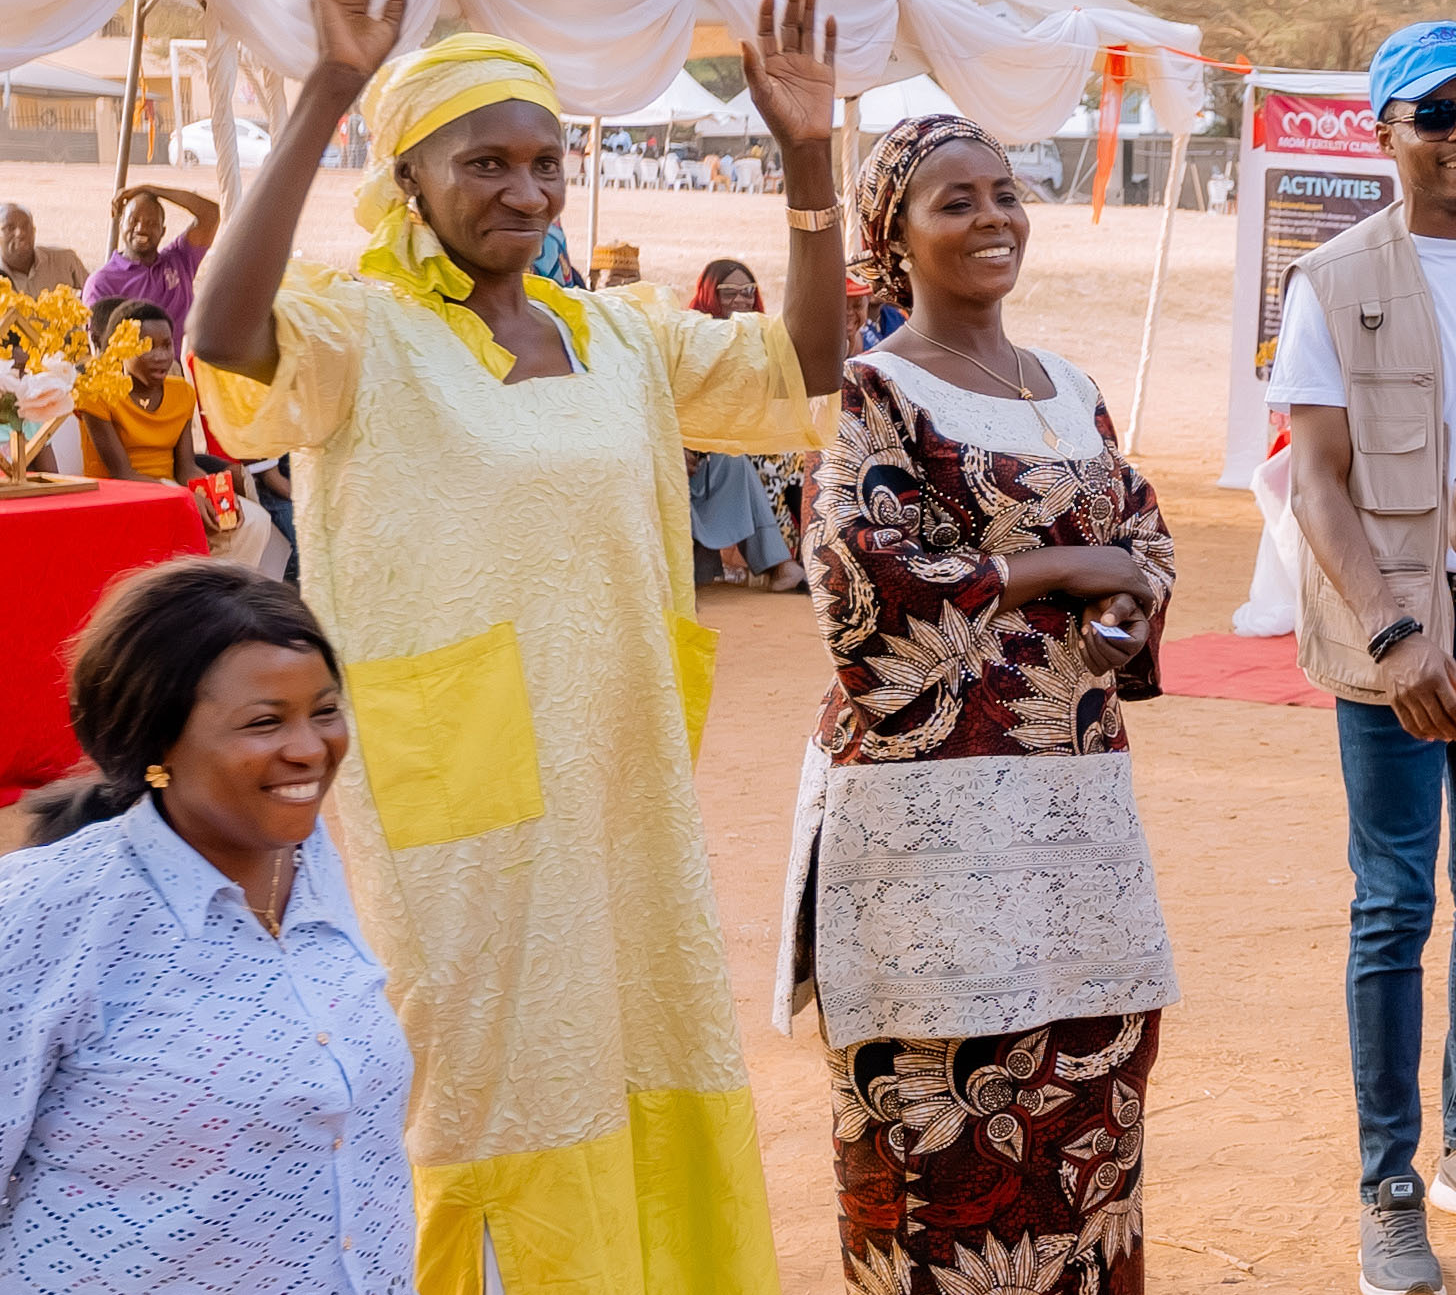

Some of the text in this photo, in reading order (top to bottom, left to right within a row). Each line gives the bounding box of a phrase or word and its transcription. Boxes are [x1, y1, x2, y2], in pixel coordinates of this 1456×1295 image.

[1278, 136, 1305, 147] MOM
[1306, 138, 1348, 150] FERTILITY
[1277, 175, 1382, 201] ACTIVITIES
[1394, 1183, 1410, 1192] NIKE
